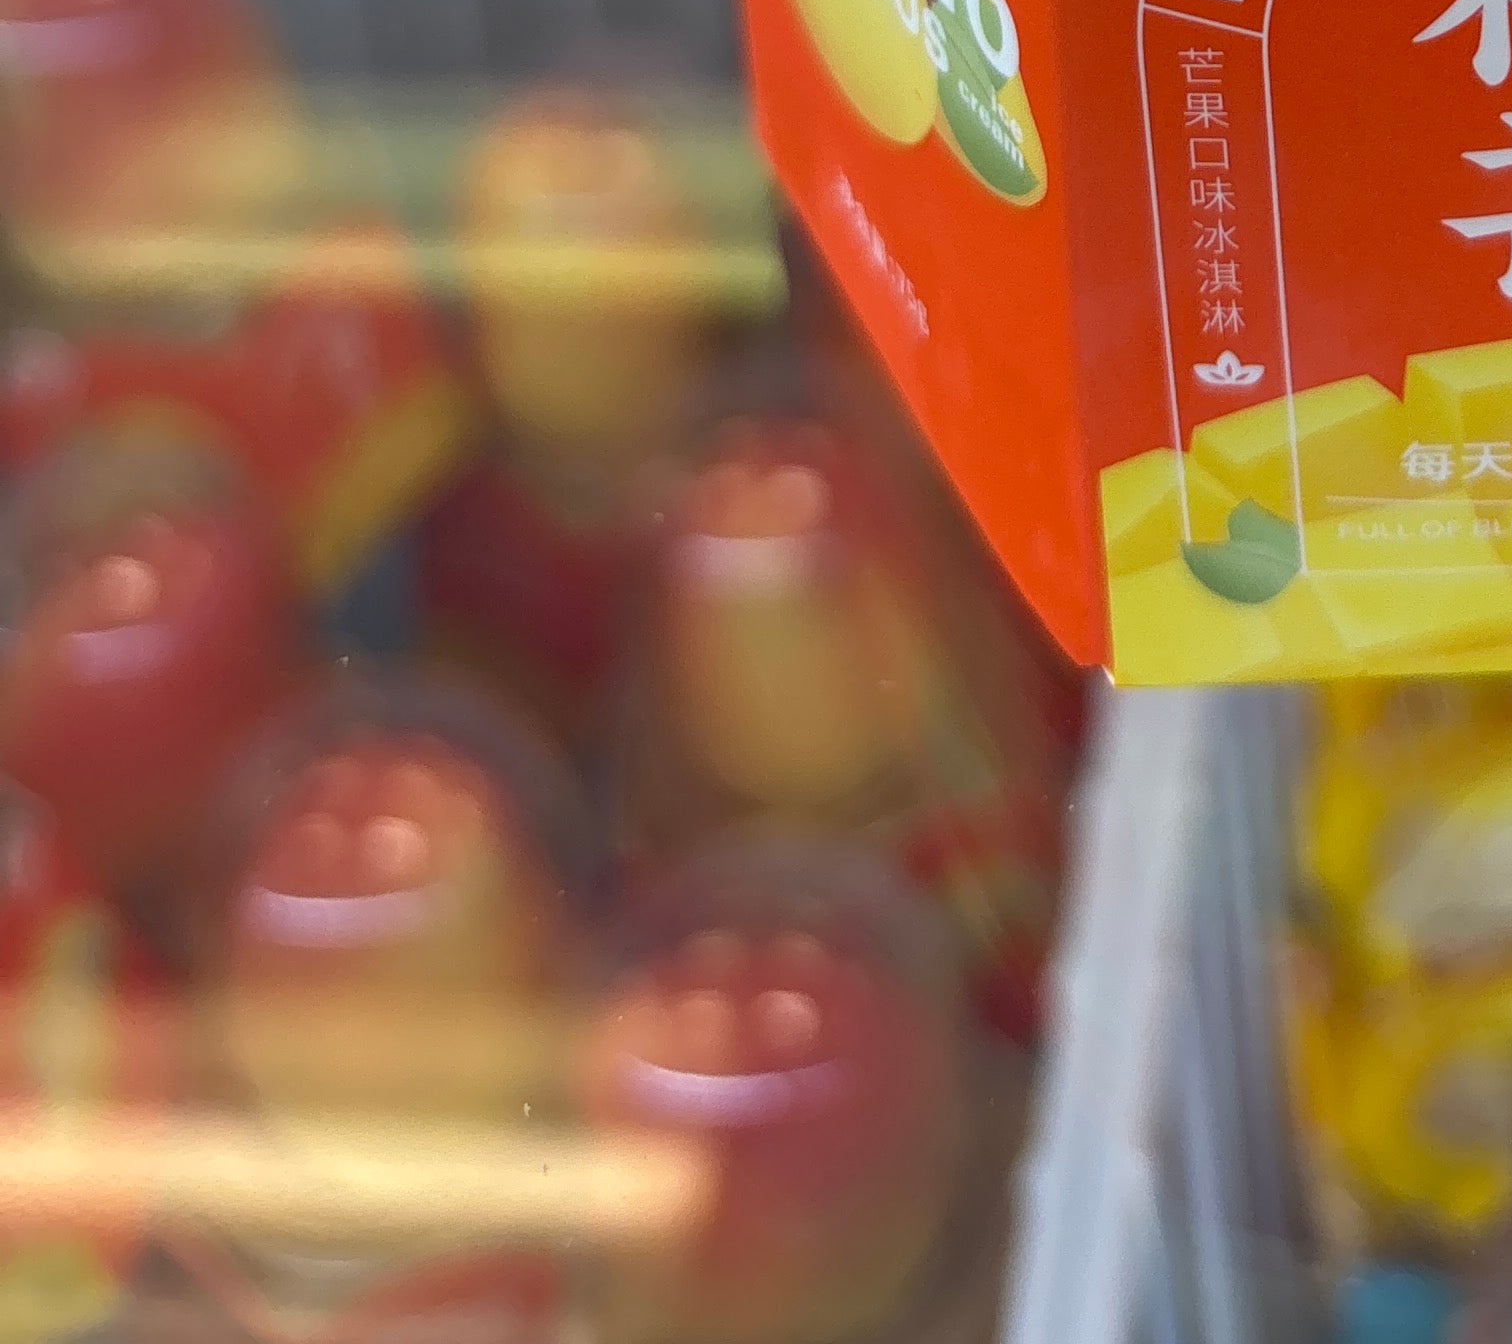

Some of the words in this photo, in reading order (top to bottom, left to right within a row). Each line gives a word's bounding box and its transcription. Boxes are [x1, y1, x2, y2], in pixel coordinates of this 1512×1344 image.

[1177, 47, 1246, 334] 芒果口味冰淇淋
[1336, 518, 1409, 541] FULL
[1419, 517, 1456, 540] OF
